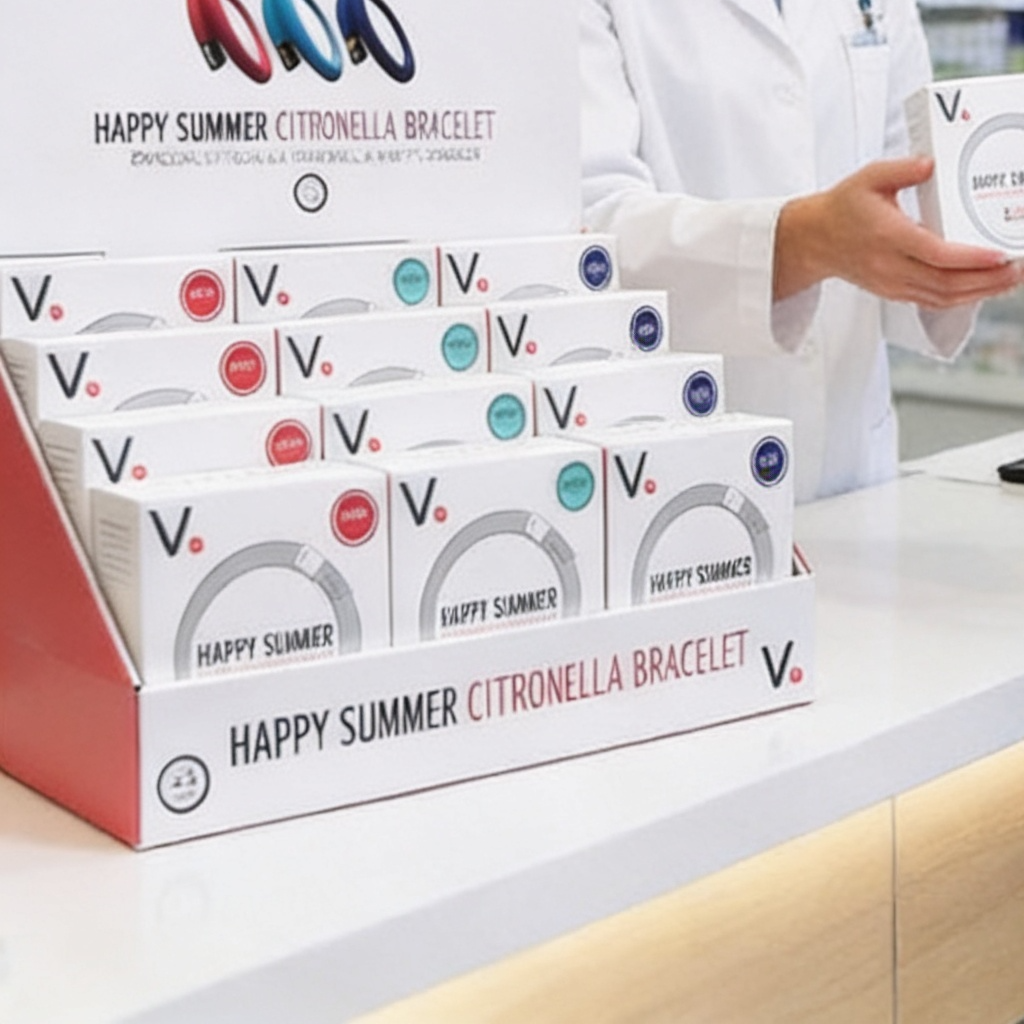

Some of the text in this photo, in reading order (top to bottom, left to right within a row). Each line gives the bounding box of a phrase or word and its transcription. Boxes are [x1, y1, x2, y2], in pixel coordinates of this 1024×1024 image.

[95, 110, 495, 144] HAPPY SUMMER CITRONELLA BRACELET
[197, 637, 257, 669] HAPPY
[230, 629, 749, 768] HAPPY SUMMER CITRONELLA BRACELET
